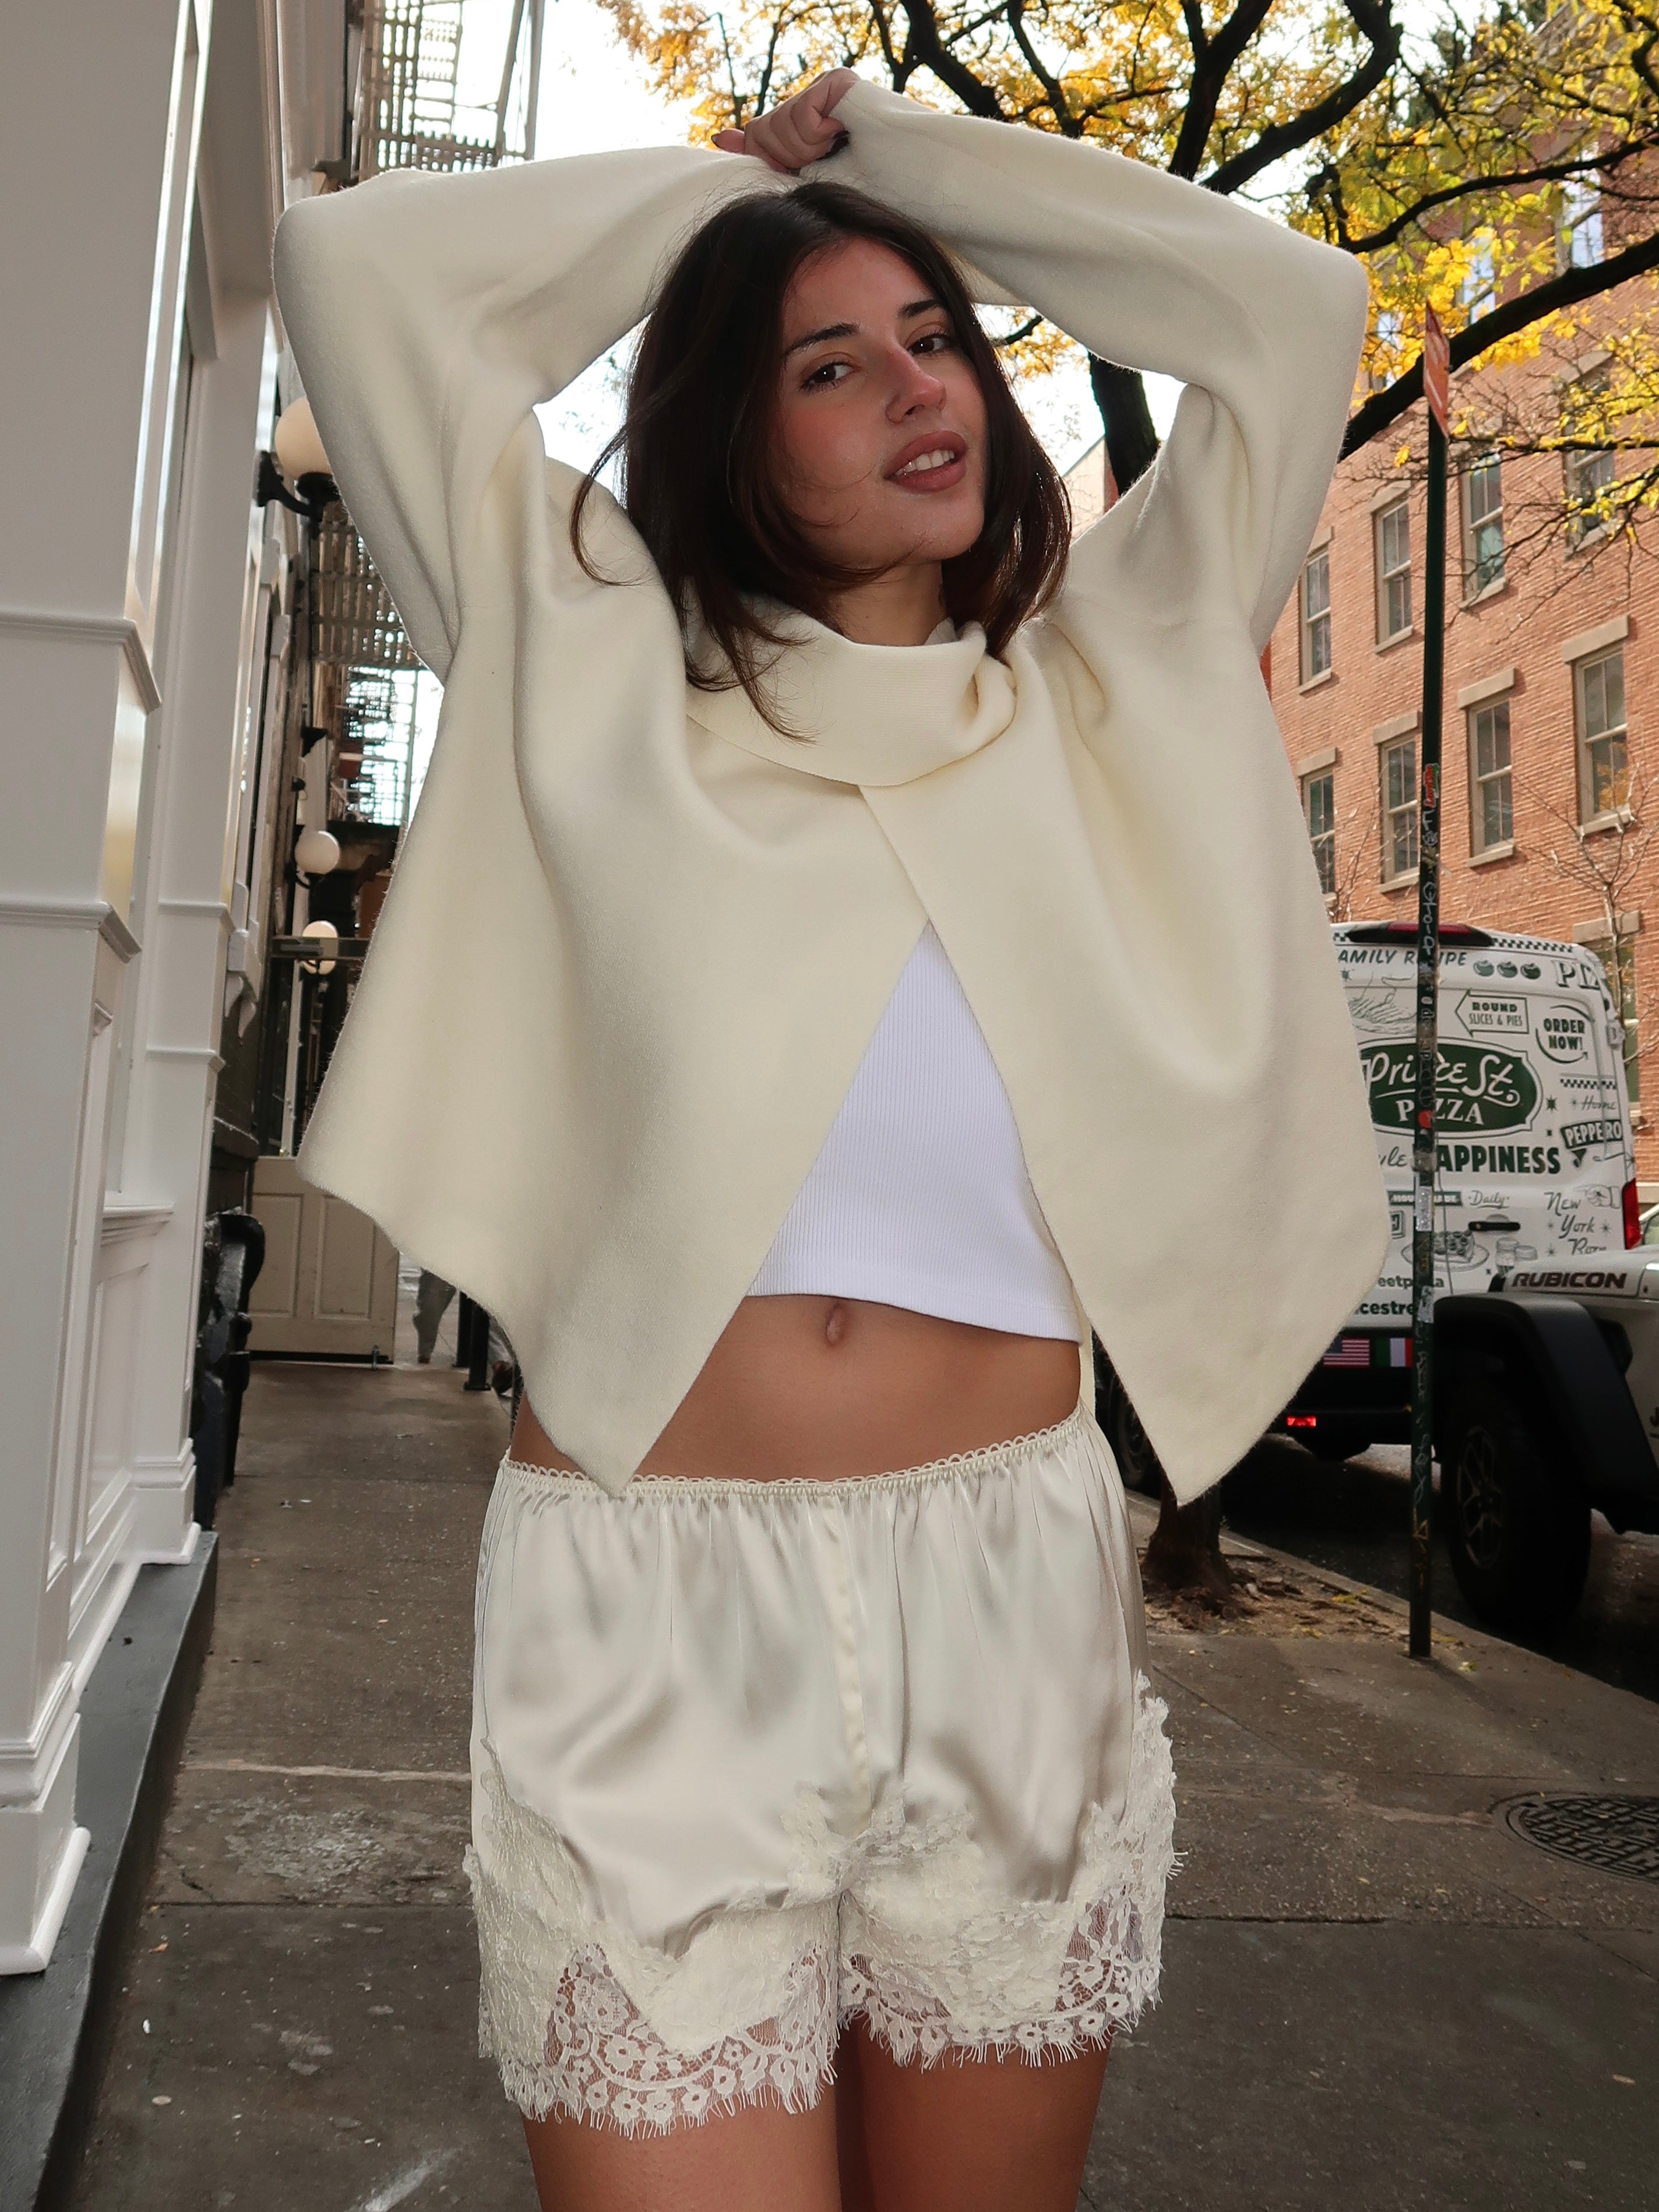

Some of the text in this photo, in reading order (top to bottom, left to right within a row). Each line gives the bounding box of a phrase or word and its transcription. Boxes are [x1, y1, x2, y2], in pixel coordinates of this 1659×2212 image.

[1339, 949, 1467, 966] AMILY RIPE
[1472, 1002, 1518, 1013] ROUND
[1468, 1013, 1494, 1025] SLICES
[1507, 1016, 1523, 1027] PIES
[1544, 1018, 1586, 1034] ORDER
[1548, 1035, 1584, 1051] NOW!
[1361, 1052, 1468, 1087] Price
[1396, 1098, 1485, 1125] PZZA
[1436, 1144, 1561, 1175] APPINESS
[1559, 1215, 1595, 1239] York
[1512, 1272, 1628, 1290] RUBICON
